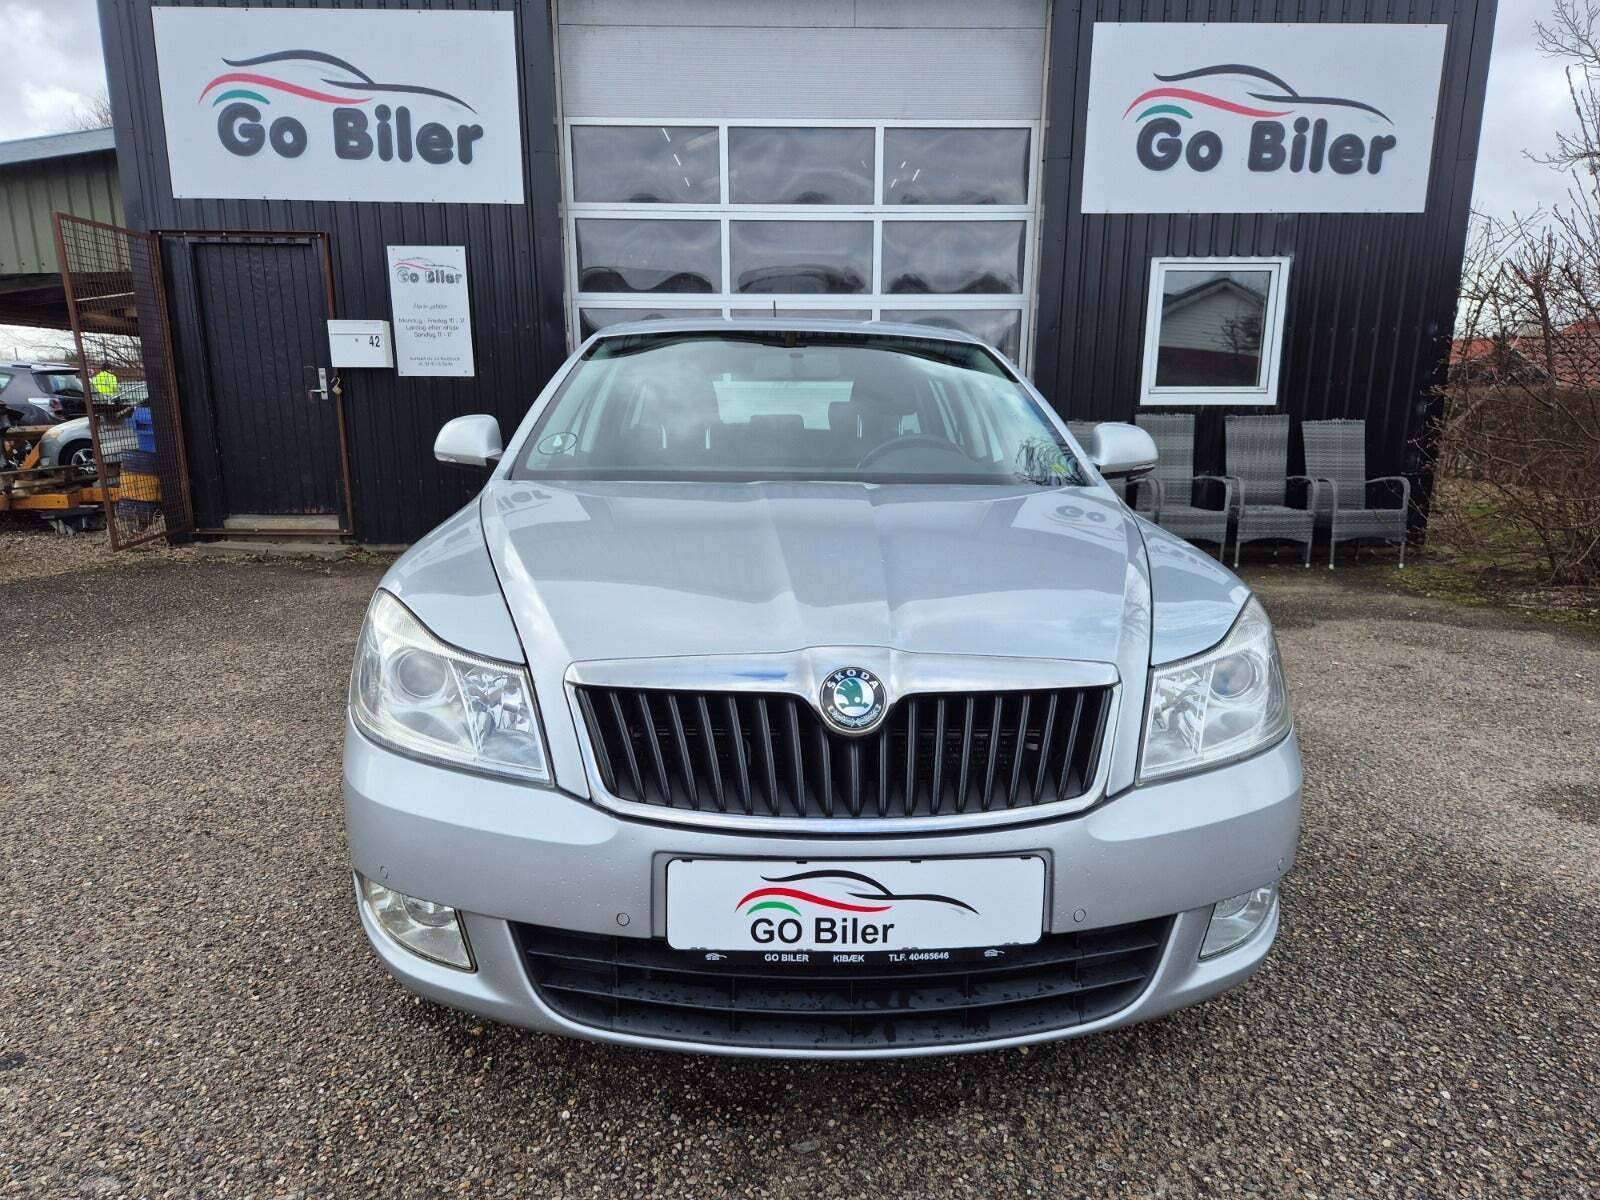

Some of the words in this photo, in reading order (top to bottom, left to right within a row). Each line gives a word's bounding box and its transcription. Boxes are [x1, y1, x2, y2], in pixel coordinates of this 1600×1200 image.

[217, 102, 307, 158] Go
[332, 104, 484, 165] Biler
[1136, 117, 1223, 172] Go
[1247, 116, 1397, 175] Biler
[397, 269, 419, 284] Go
[425, 269, 463, 284] Biler
[369, 335, 381, 347] 42
[750, 917, 803, 944] GO
[814, 917, 895, 945] Biler
[764, 953, 779, 962] GO
[781, 953, 809, 963] BILER
[832, 954, 865, 963] KIBÆK
[888, 953, 907, 962] TLF.
